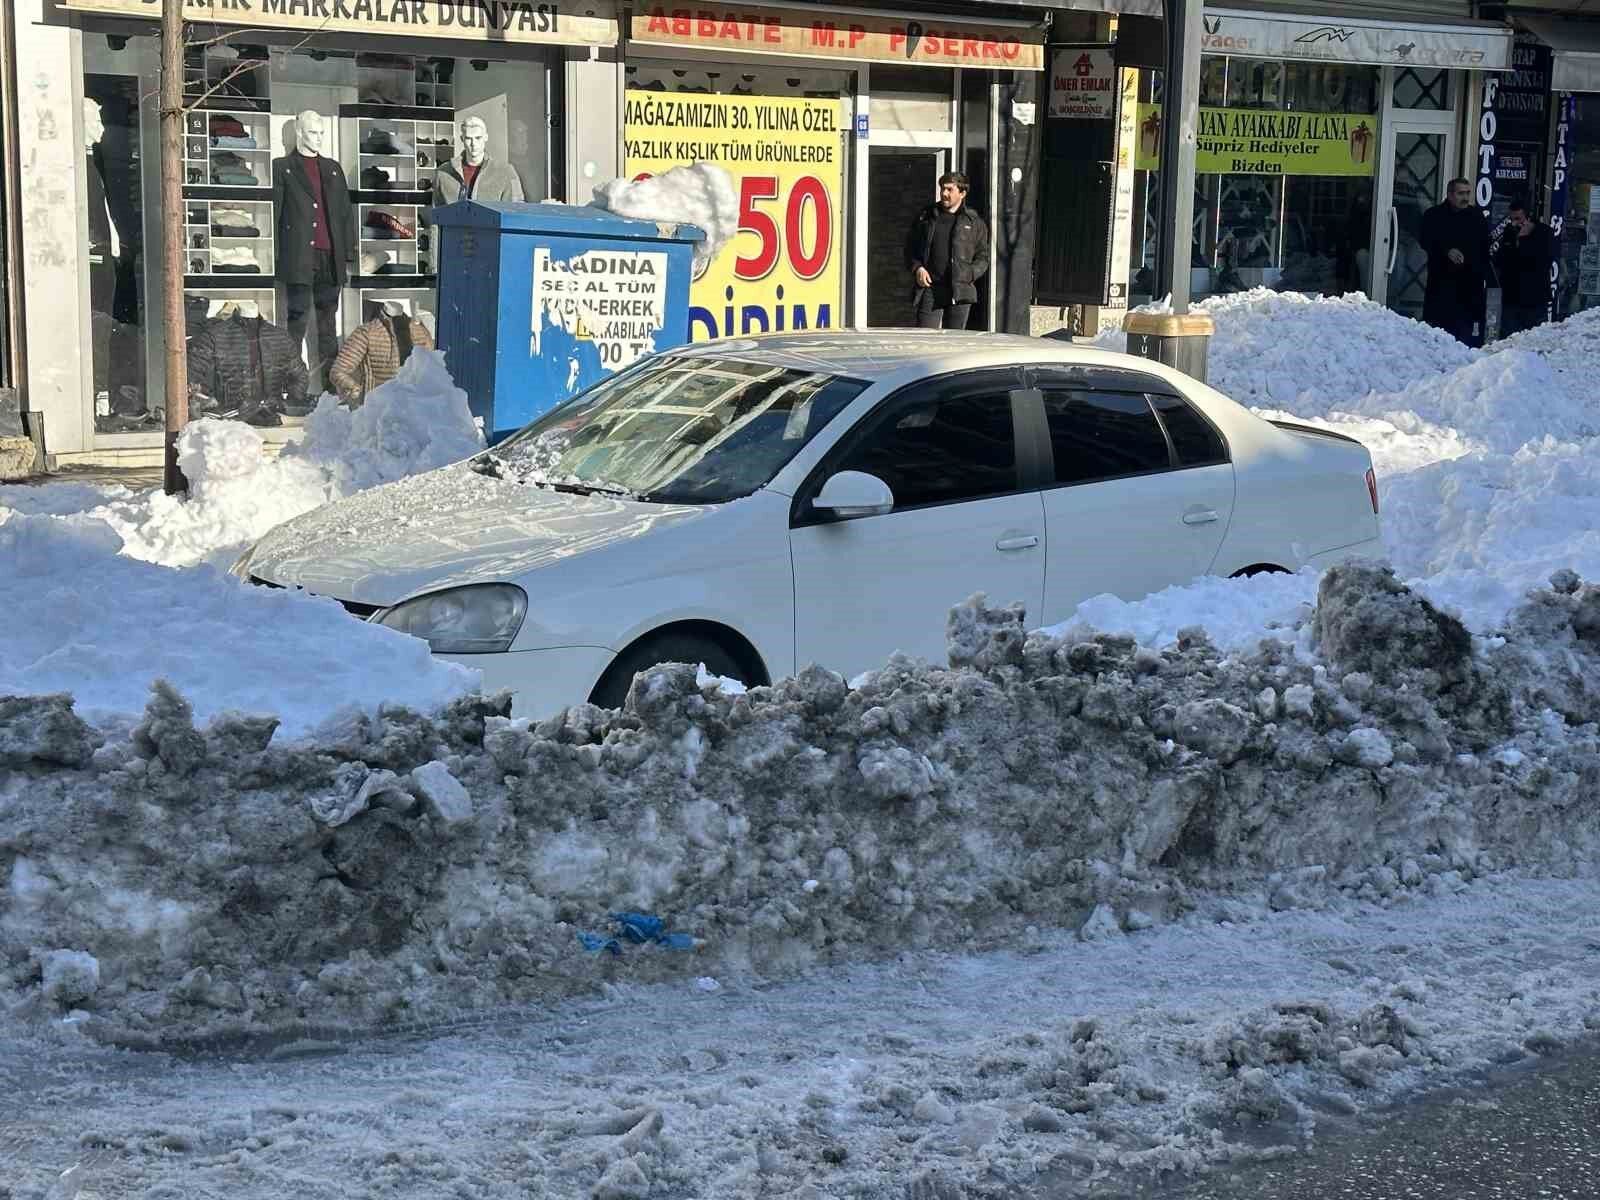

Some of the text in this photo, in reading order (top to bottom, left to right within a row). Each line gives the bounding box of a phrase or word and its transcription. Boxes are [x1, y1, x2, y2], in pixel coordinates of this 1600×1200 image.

[811, 20, 866, 49] M.P
[624, 97, 837, 132] MAĞAZAMIZIN 30. YILINA ÖZEL
[1196, 111, 1349, 141] YAN AYAKKABI ALANA
[624, 140, 833, 163] YAZLIK KIŞLIK TÜM ÜRÜNLERDE
[1250, 140, 1320, 158] Hediyeler
[1475, 78, 1499, 217] FOTO
[1231, 158, 1282, 174] Bizden
[585, 281, 609, 293] AL
[615, 279, 656, 294] TÜM
